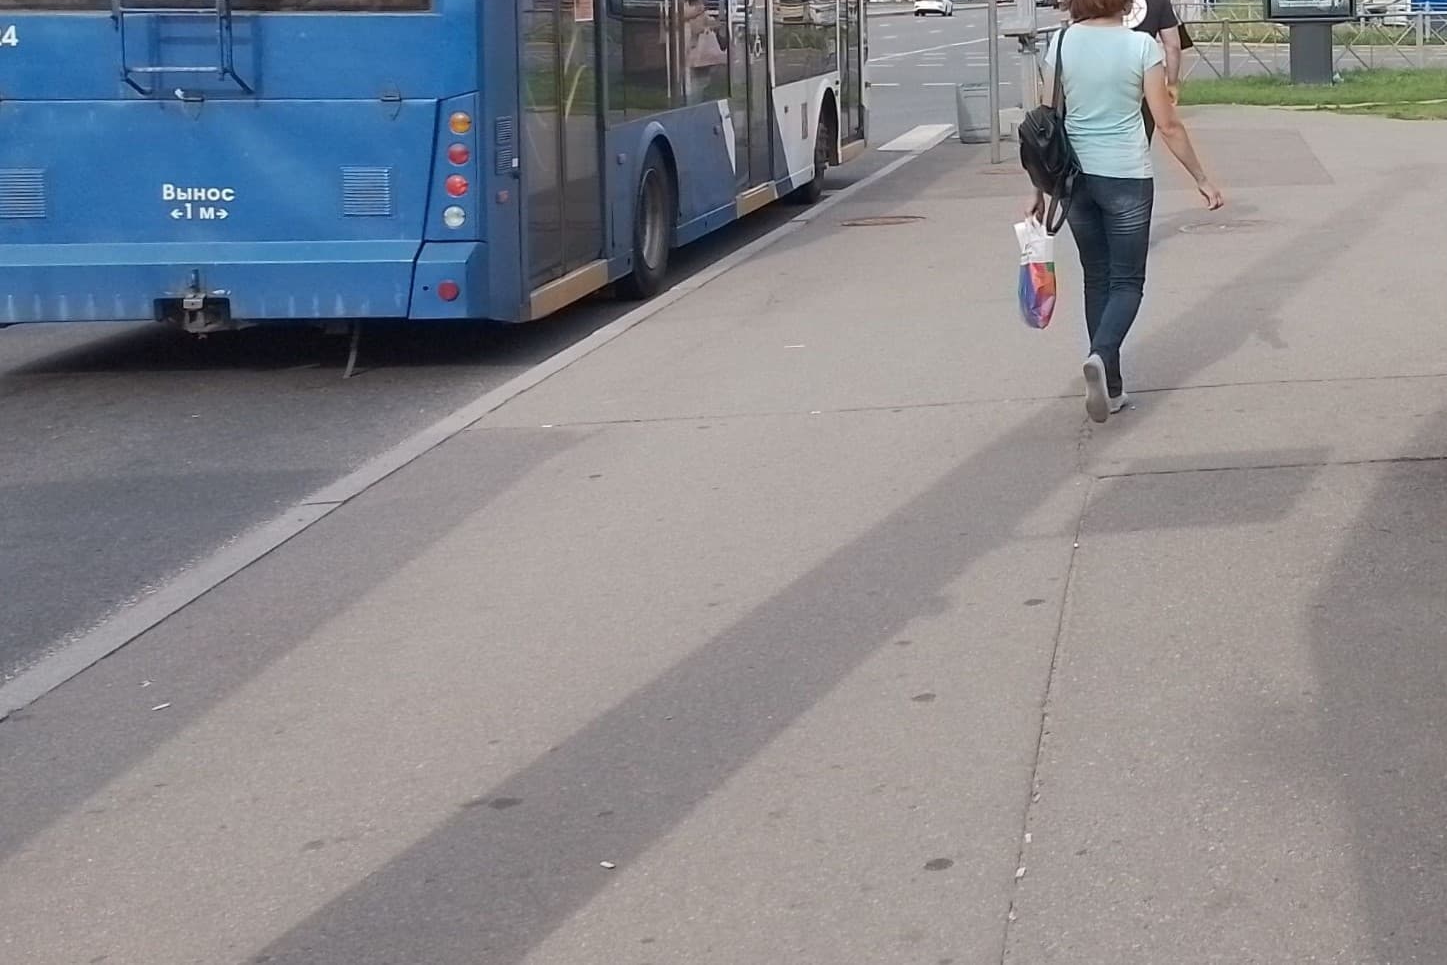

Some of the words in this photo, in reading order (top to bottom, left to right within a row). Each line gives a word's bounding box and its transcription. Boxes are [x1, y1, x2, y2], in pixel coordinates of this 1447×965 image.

[0, 25, 19, 47] 4
[162, 183, 236, 202] Вынос
[184, 202, 193, 220] 1
[199, 206, 215, 220] м
